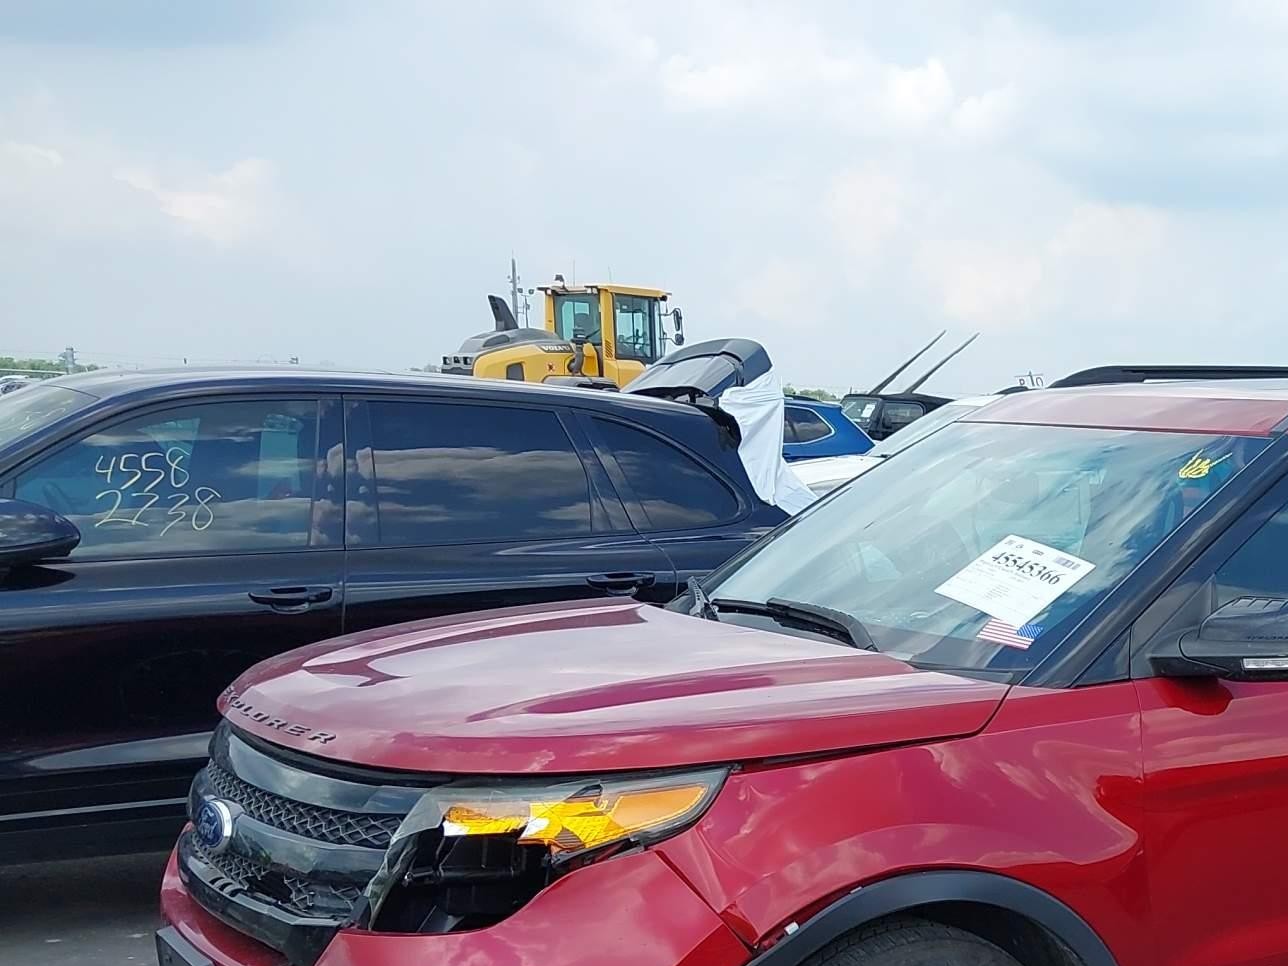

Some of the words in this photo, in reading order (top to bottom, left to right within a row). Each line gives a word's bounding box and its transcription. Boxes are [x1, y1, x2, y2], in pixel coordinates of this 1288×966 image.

[95, 446, 191, 492] 4558
[94, 486, 222, 537] 2738
[991, 551, 1067, 585] 45545366
